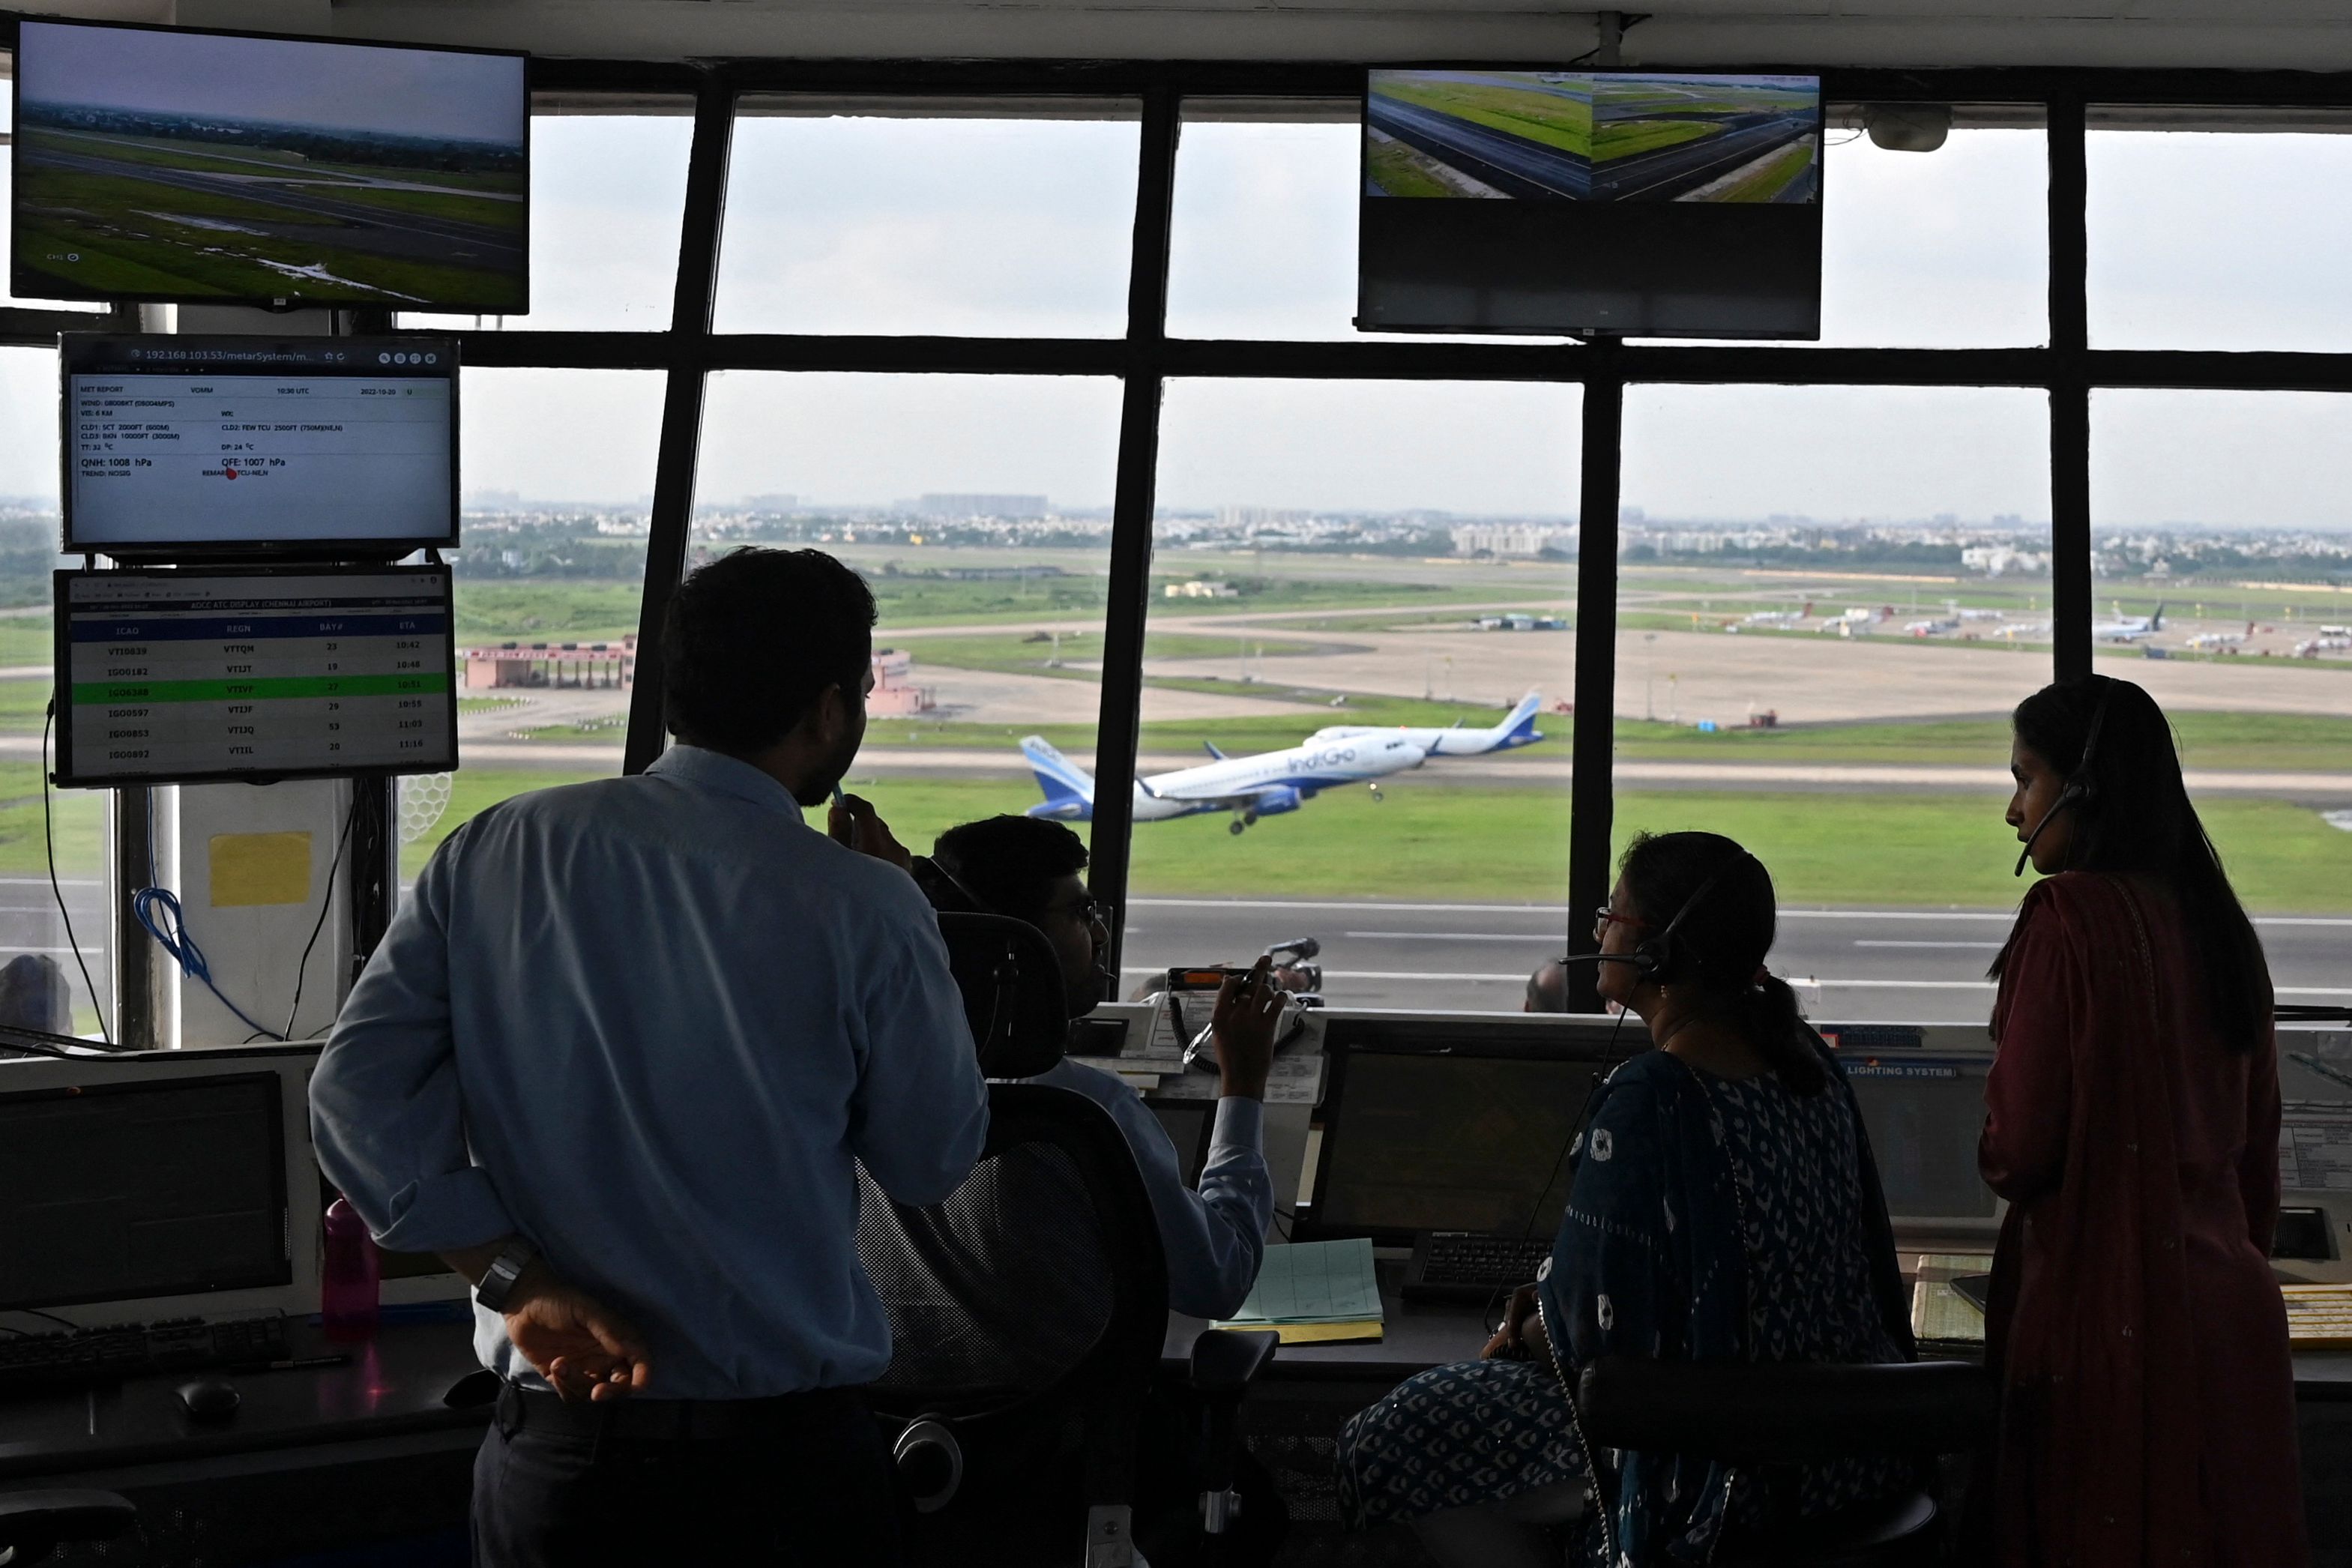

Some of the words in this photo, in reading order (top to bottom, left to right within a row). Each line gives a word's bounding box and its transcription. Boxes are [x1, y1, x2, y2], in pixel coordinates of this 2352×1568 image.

[81, 458, 106, 468] QNH:
[109, 458, 130, 467] 1008
[135, 458, 152, 467] hPa
[221, 458, 241, 468] QFE:
[244, 458, 265, 467] 1007
[269, 458, 286, 467] hPa
[214, 601, 229, 609] ATC
[229, 600, 260, 609] DISPLAY
[262, 600, 296, 609] (CHENNAI
[298, 599, 332, 608] AIRPORT)
[227, 625, 251, 633] REGN
[319, 623, 343, 631] BAY#
[399, 621, 416, 630] ETA
[115, 627, 139, 636] ICAO
[396, 641, 420, 649] 10:42
[108, 668, 148, 677] IGO0182
[397, 681, 421, 689] 10:51
[109, 709, 149, 717] IGO0597
[399, 720, 422, 728] 11:03
[109, 730, 149, 738] IGO0853
[228, 726, 254, 735] VTIJQ
[399, 740, 423, 748] 11:16
[109, 750, 149, 759] IGO0892
[1288, 747, 1356, 774] IndiGo
[1848, 1066, 1903, 1076] LIGHTING
[1906, 1067, 1957, 1077] SYSTEM)
